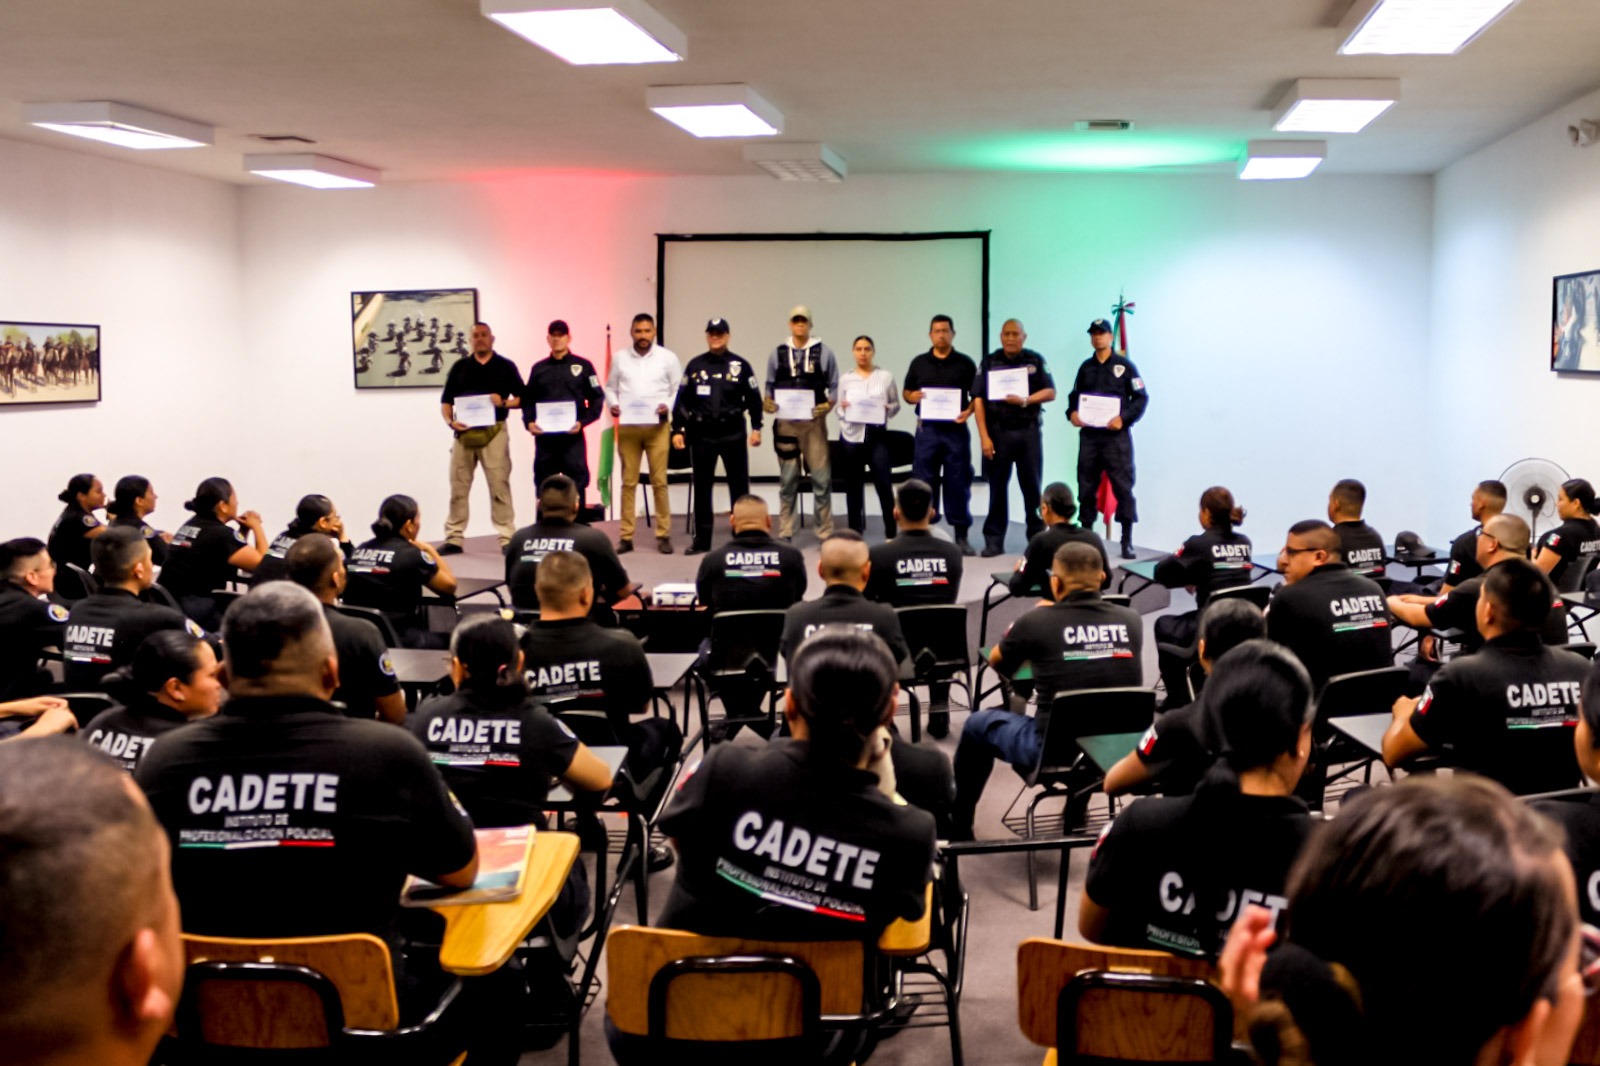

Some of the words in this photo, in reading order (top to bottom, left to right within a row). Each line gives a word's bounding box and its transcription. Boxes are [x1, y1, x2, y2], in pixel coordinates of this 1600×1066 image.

[351, 549, 395, 563] CADETE
[523, 538, 575, 552] CADETE
[1348, 548, 1382, 564] CADETE
[725, 551, 780, 565] CADETE
[896, 558, 947, 574] CADETE
[1330, 595, 1384, 617] CADETE
[66, 625, 115, 648] CADETE
[1063, 624, 1130, 644] CADETE
[524, 661, 602, 689] CADETE
[1506, 682, 1580, 708] CADETE
[427, 716, 521, 744] CADETE
[88, 730, 155, 758] CADET
[188, 773, 339, 815] CADETE
[275, 813, 289, 825] DE
[733, 810, 880, 890] CADETE
[763, 866, 814, 889] INSTITUTO
[814, 880, 829, 893] DE
